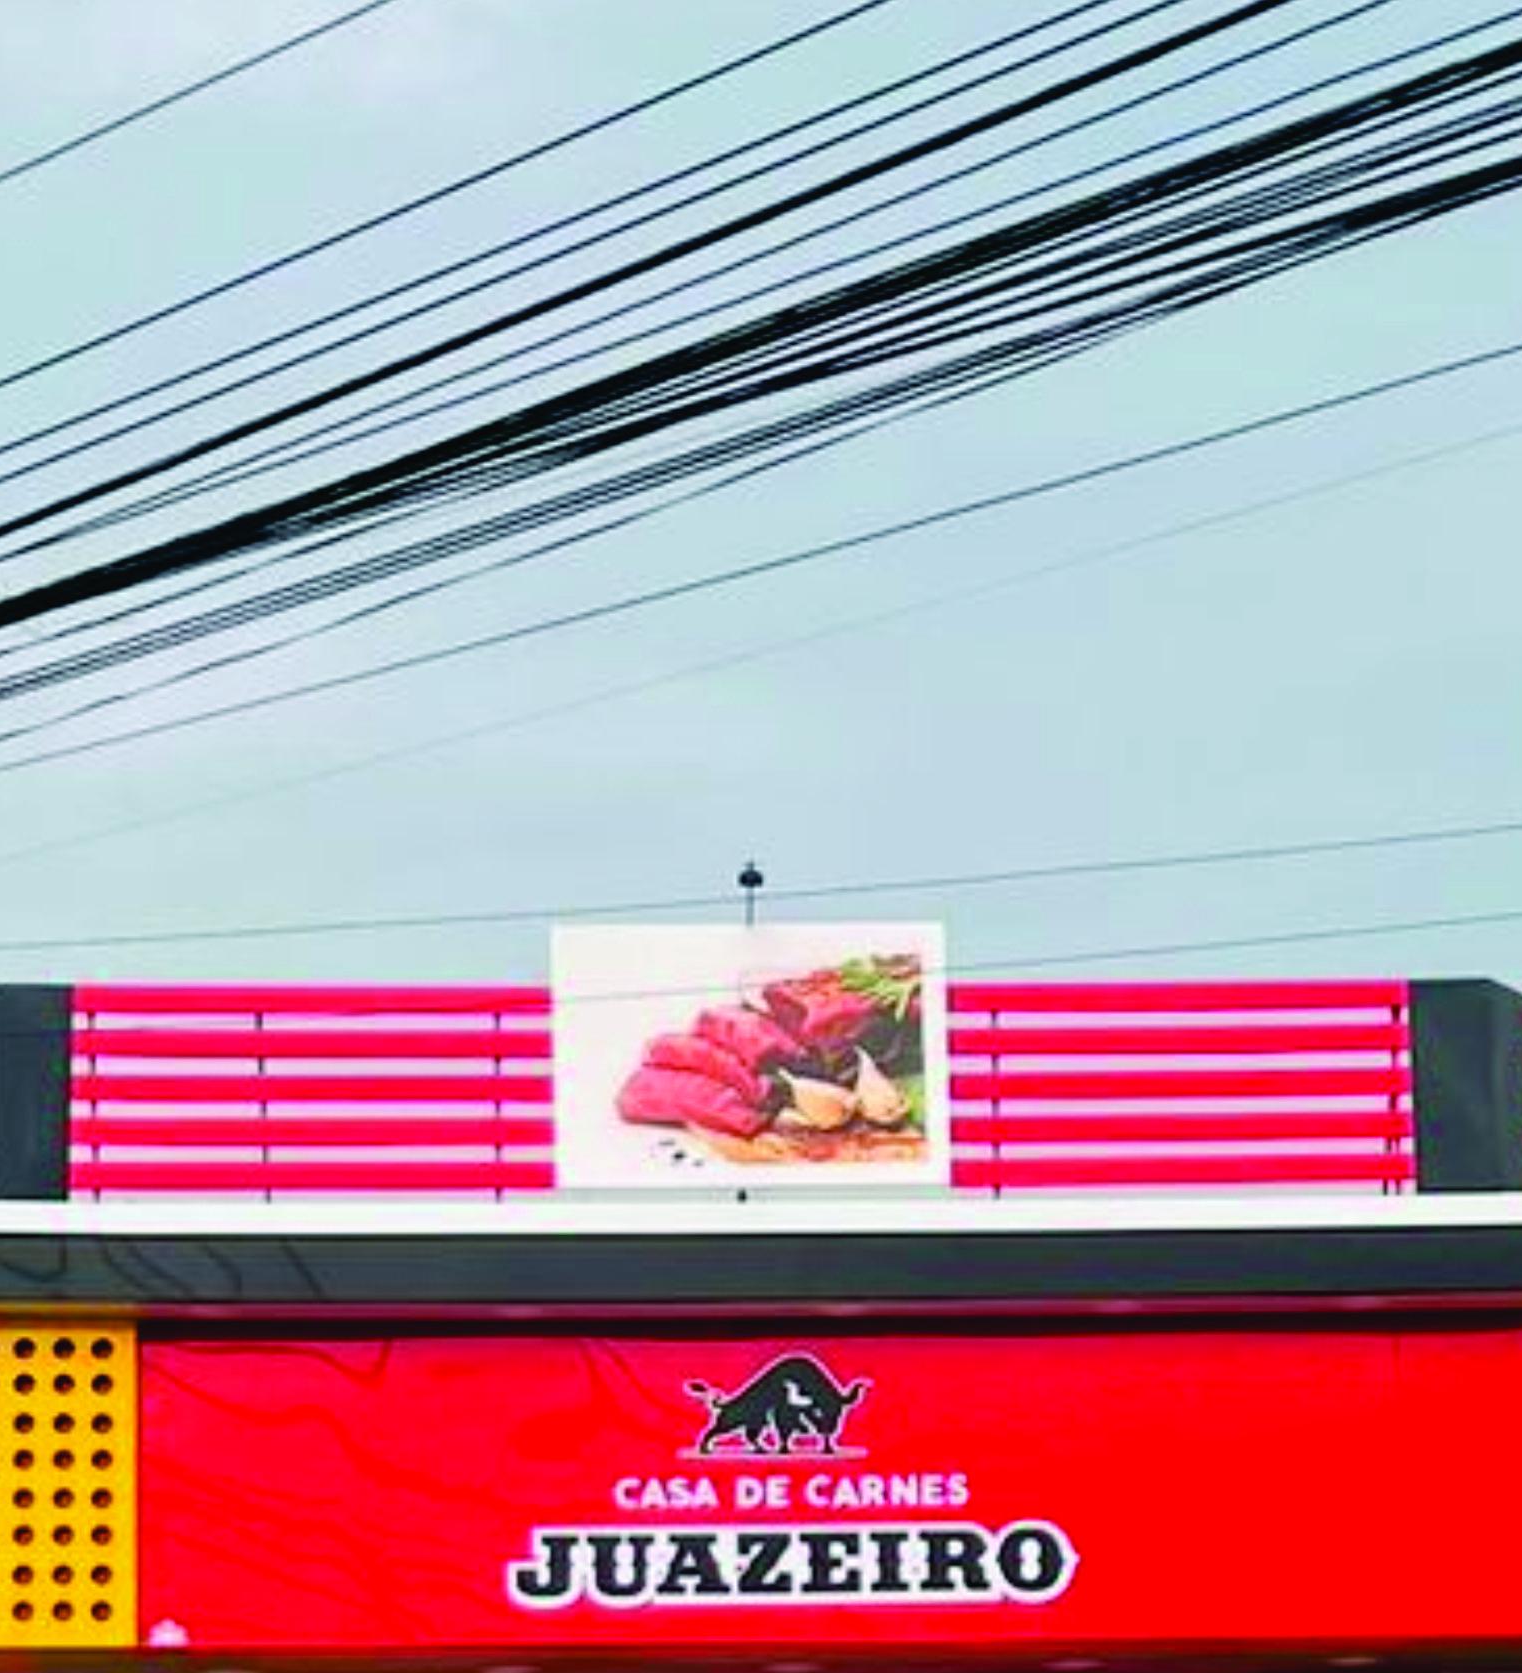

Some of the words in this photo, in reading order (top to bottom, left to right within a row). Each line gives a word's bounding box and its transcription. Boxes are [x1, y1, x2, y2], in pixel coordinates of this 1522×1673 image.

[614, 1477, 718, 1509] CASA
[735, 1477, 790, 1508] DE
[805, 1474, 970, 1507] CARNES
[513, 1526, 1065, 1598] JUAZEIRO
